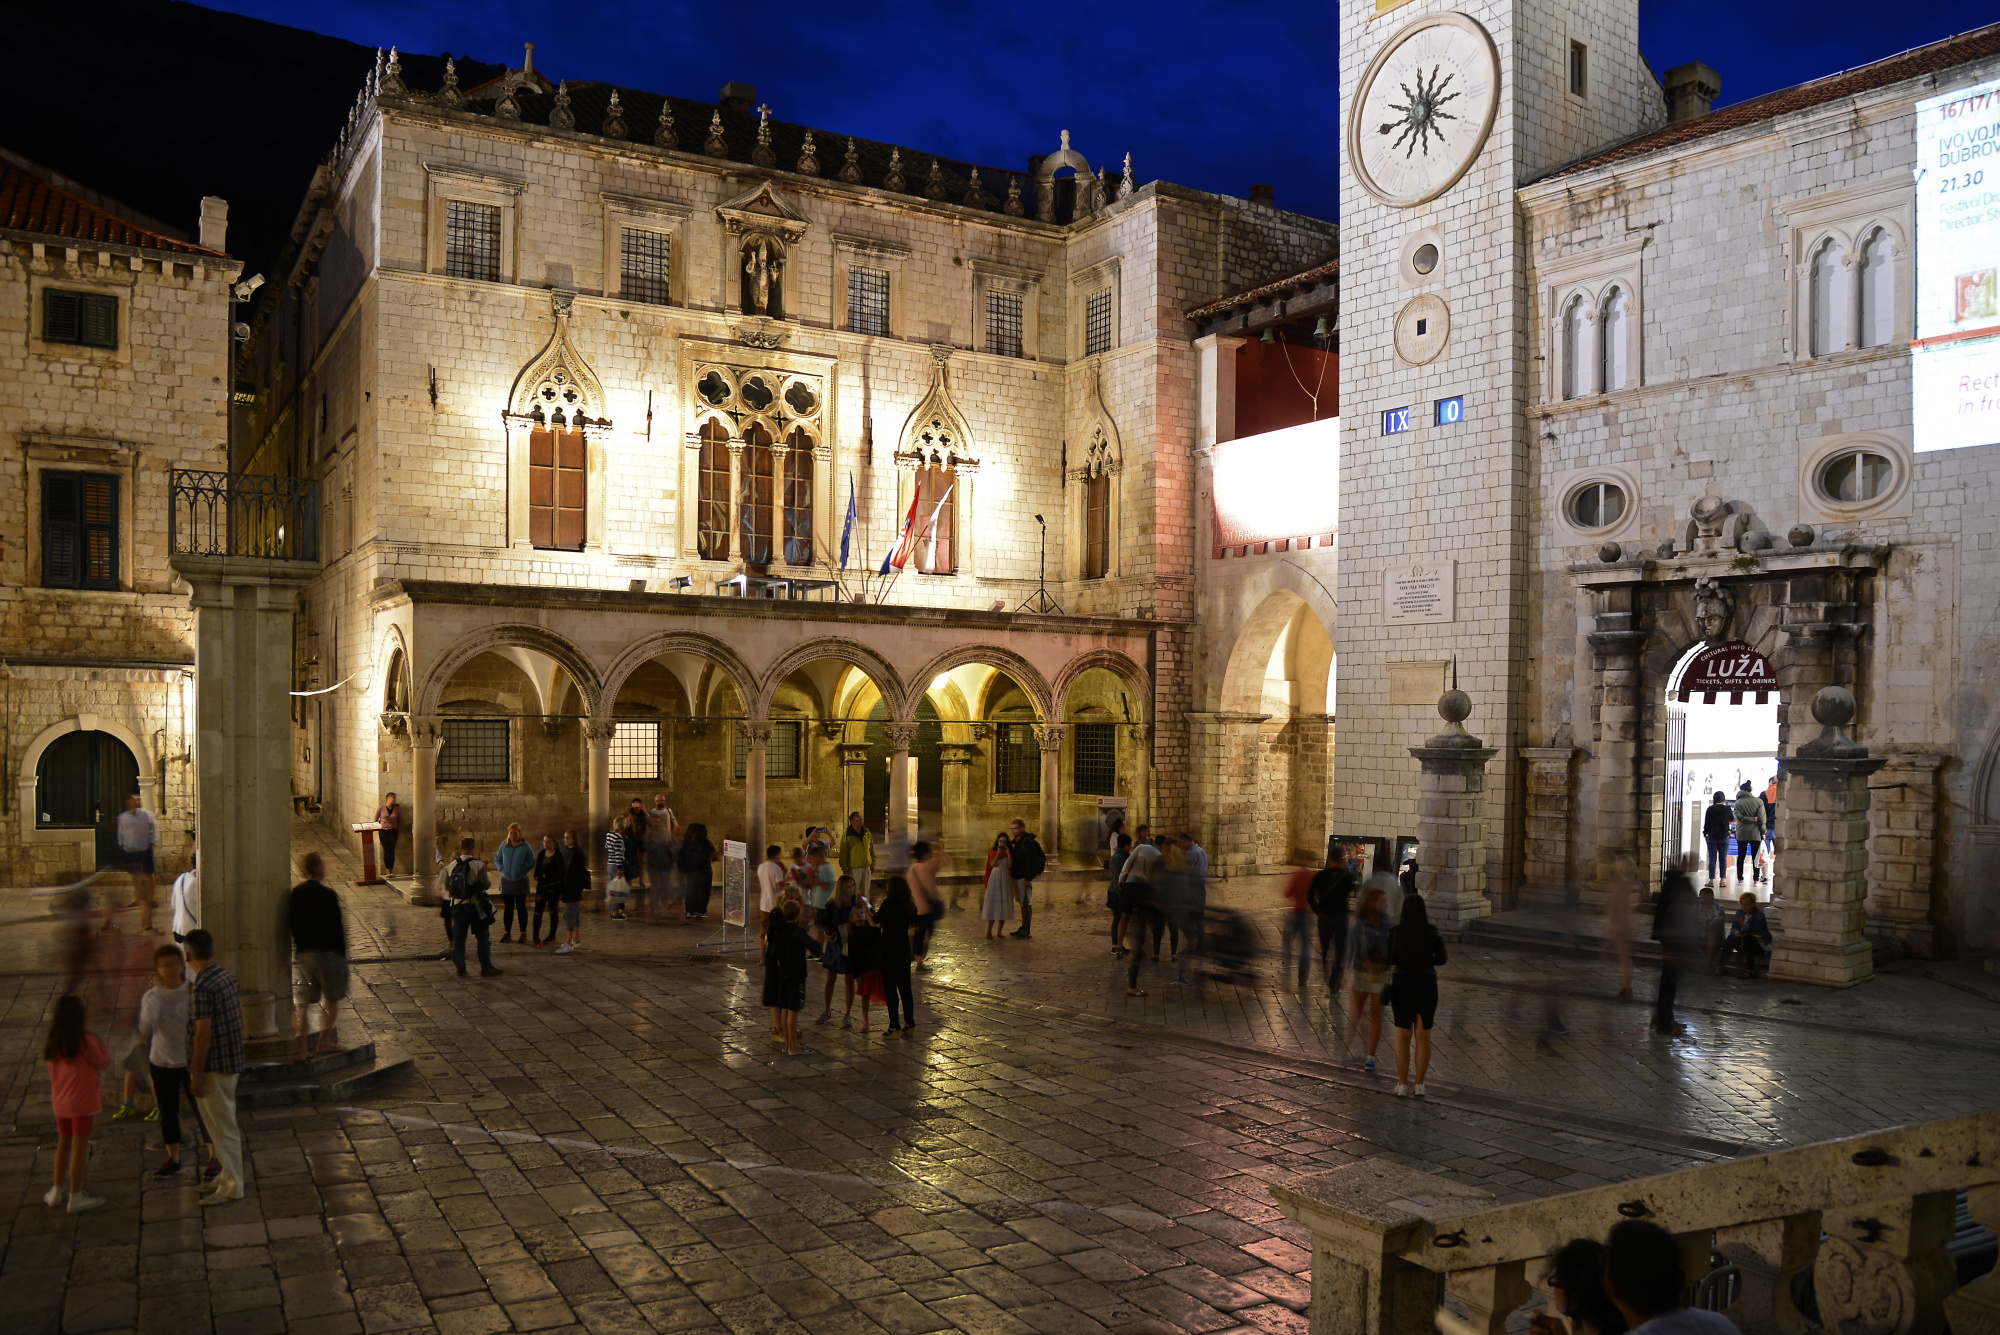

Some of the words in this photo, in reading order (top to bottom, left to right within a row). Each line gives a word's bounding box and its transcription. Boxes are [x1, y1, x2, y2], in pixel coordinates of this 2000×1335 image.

[1939, 133, 1965, 153] IVO
[1939, 170, 1984, 194] 21.30
[1939, 194, 1981, 215] Festival
[1958, 397, 1974, 415] in
[1389, 410, 1409, 433] IX
[1700, 646, 1729, 662] CULTURAL
[1706, 653, 1765, 677] LUŽA
